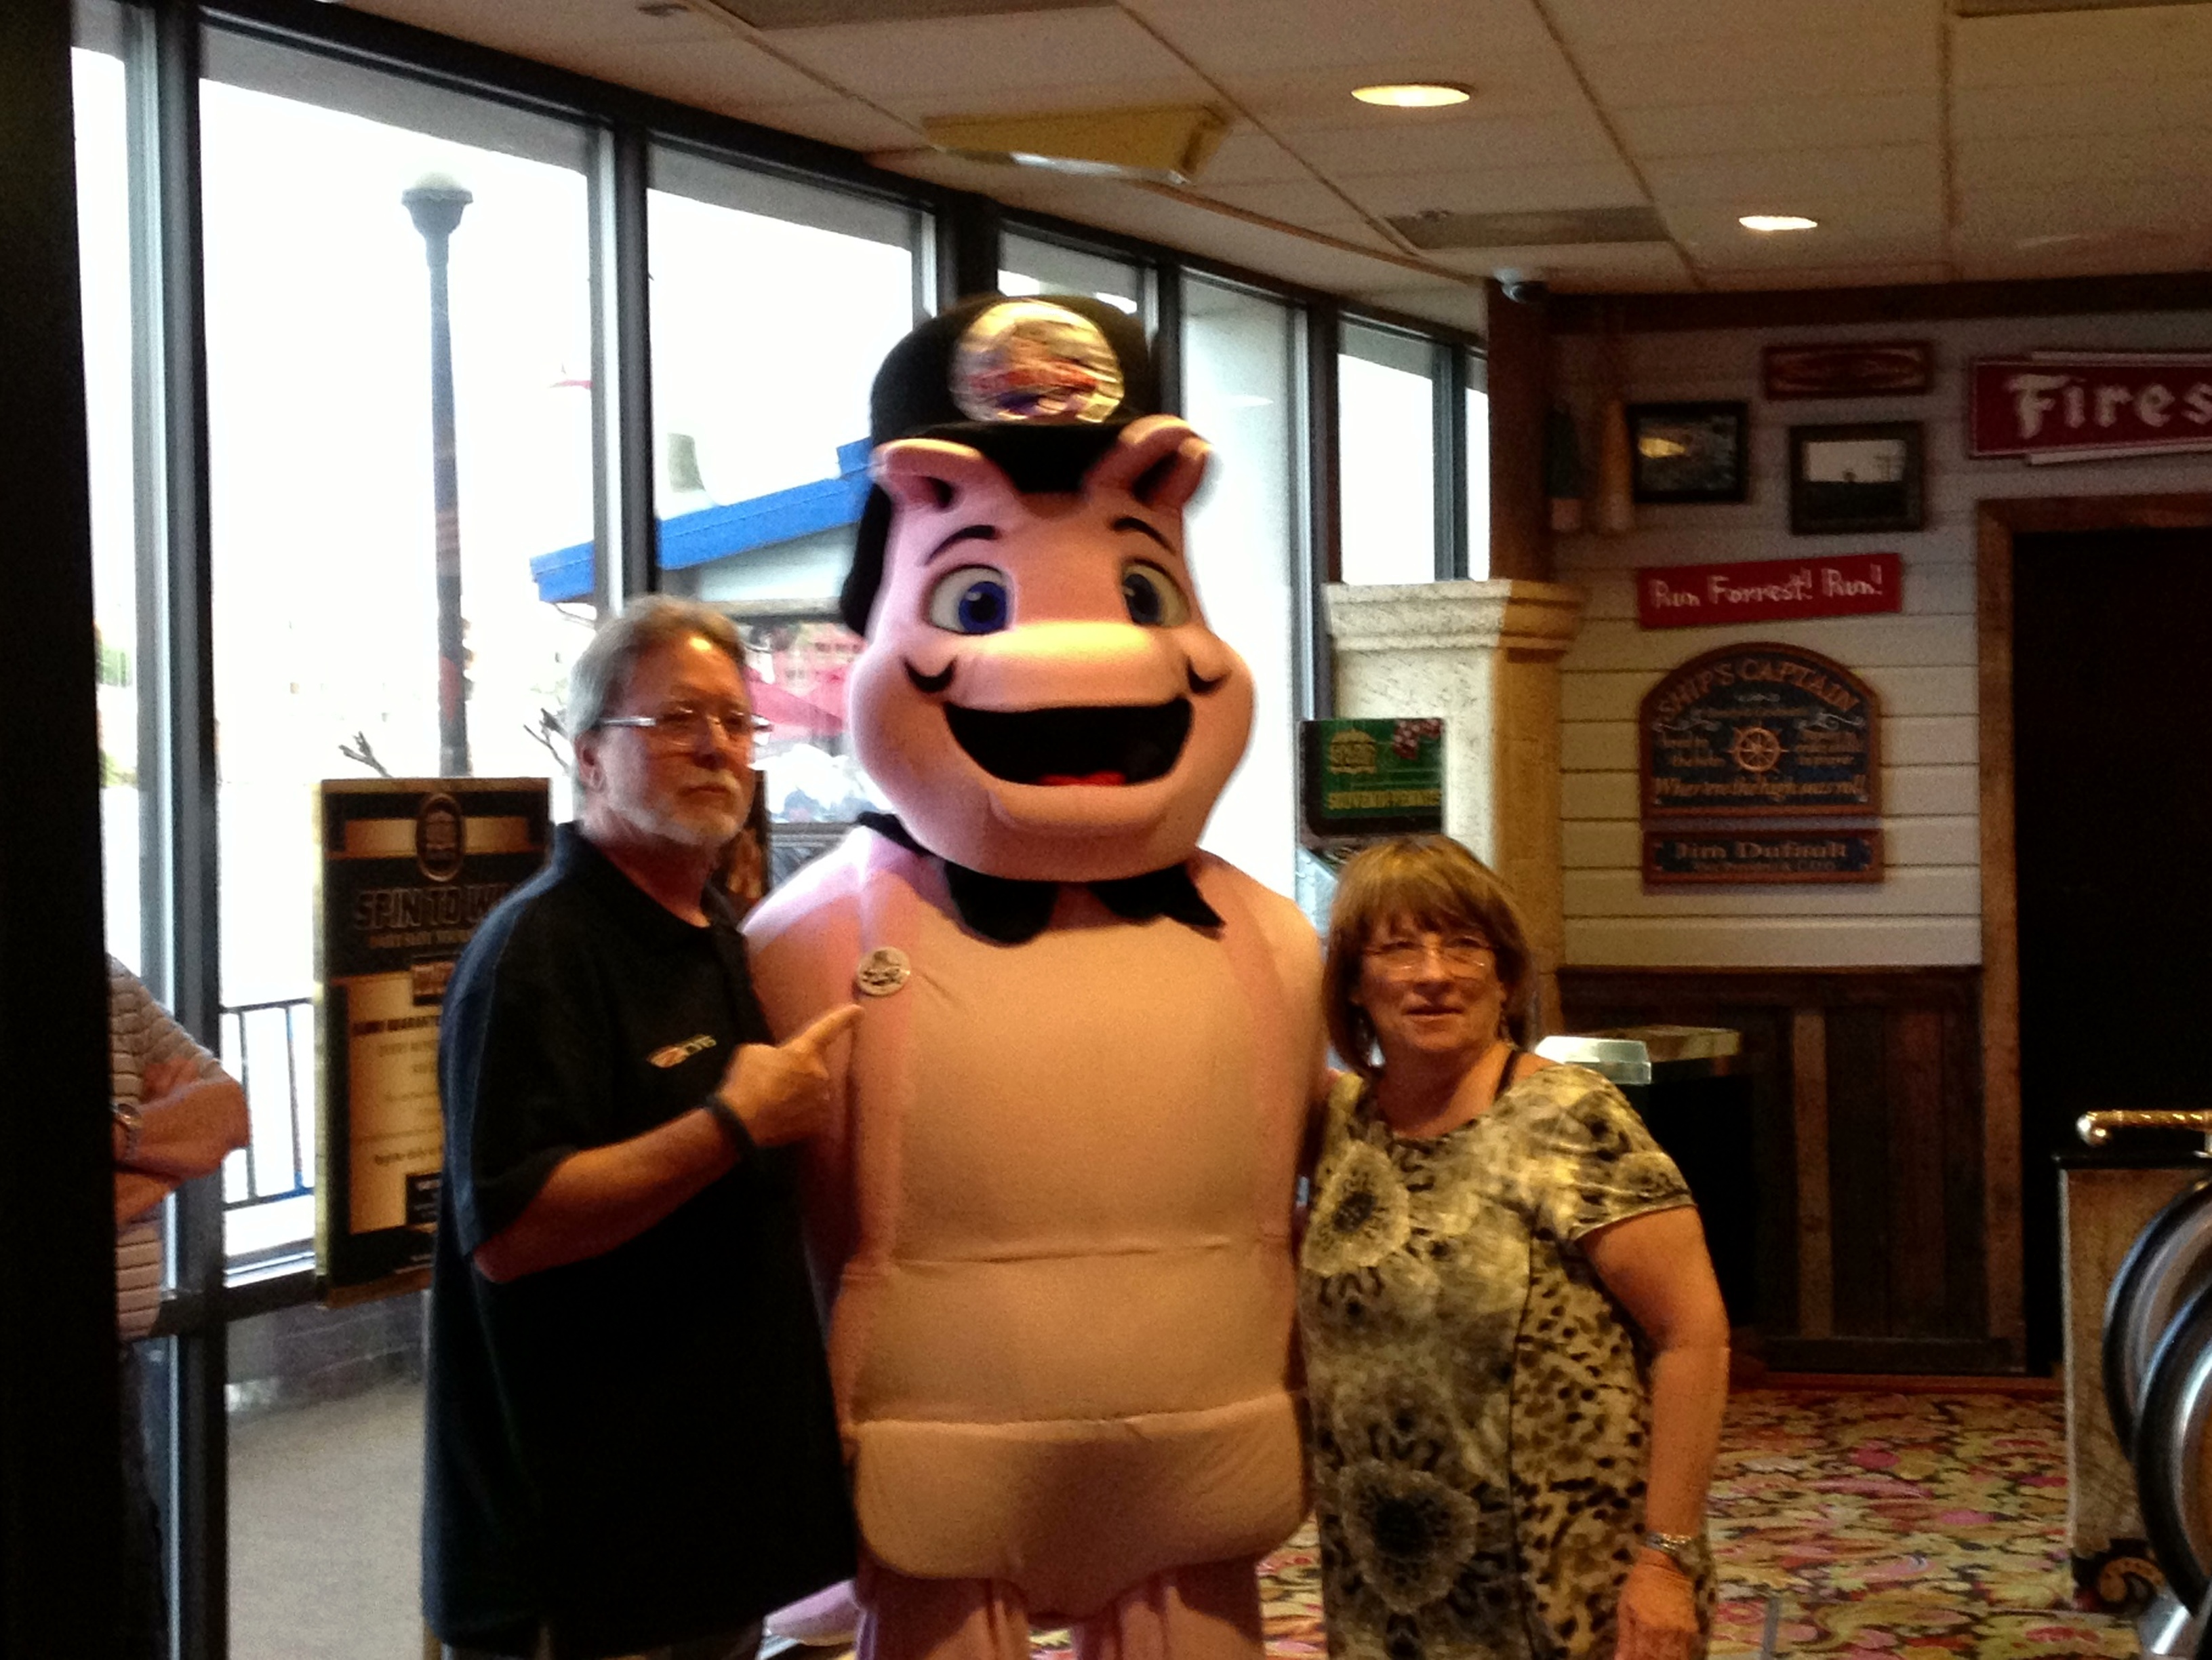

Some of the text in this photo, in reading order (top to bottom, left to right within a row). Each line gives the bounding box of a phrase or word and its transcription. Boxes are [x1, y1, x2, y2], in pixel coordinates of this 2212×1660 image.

[2002, 374, 2212, 439] Fires
[1648, 564, 1883, 608] Run Forrest! Run!
[1740, 658, 1861, 711] CAPTAIN
[353, 888, 422, 930] SPIN
[424, 885, 462, 926] TO
